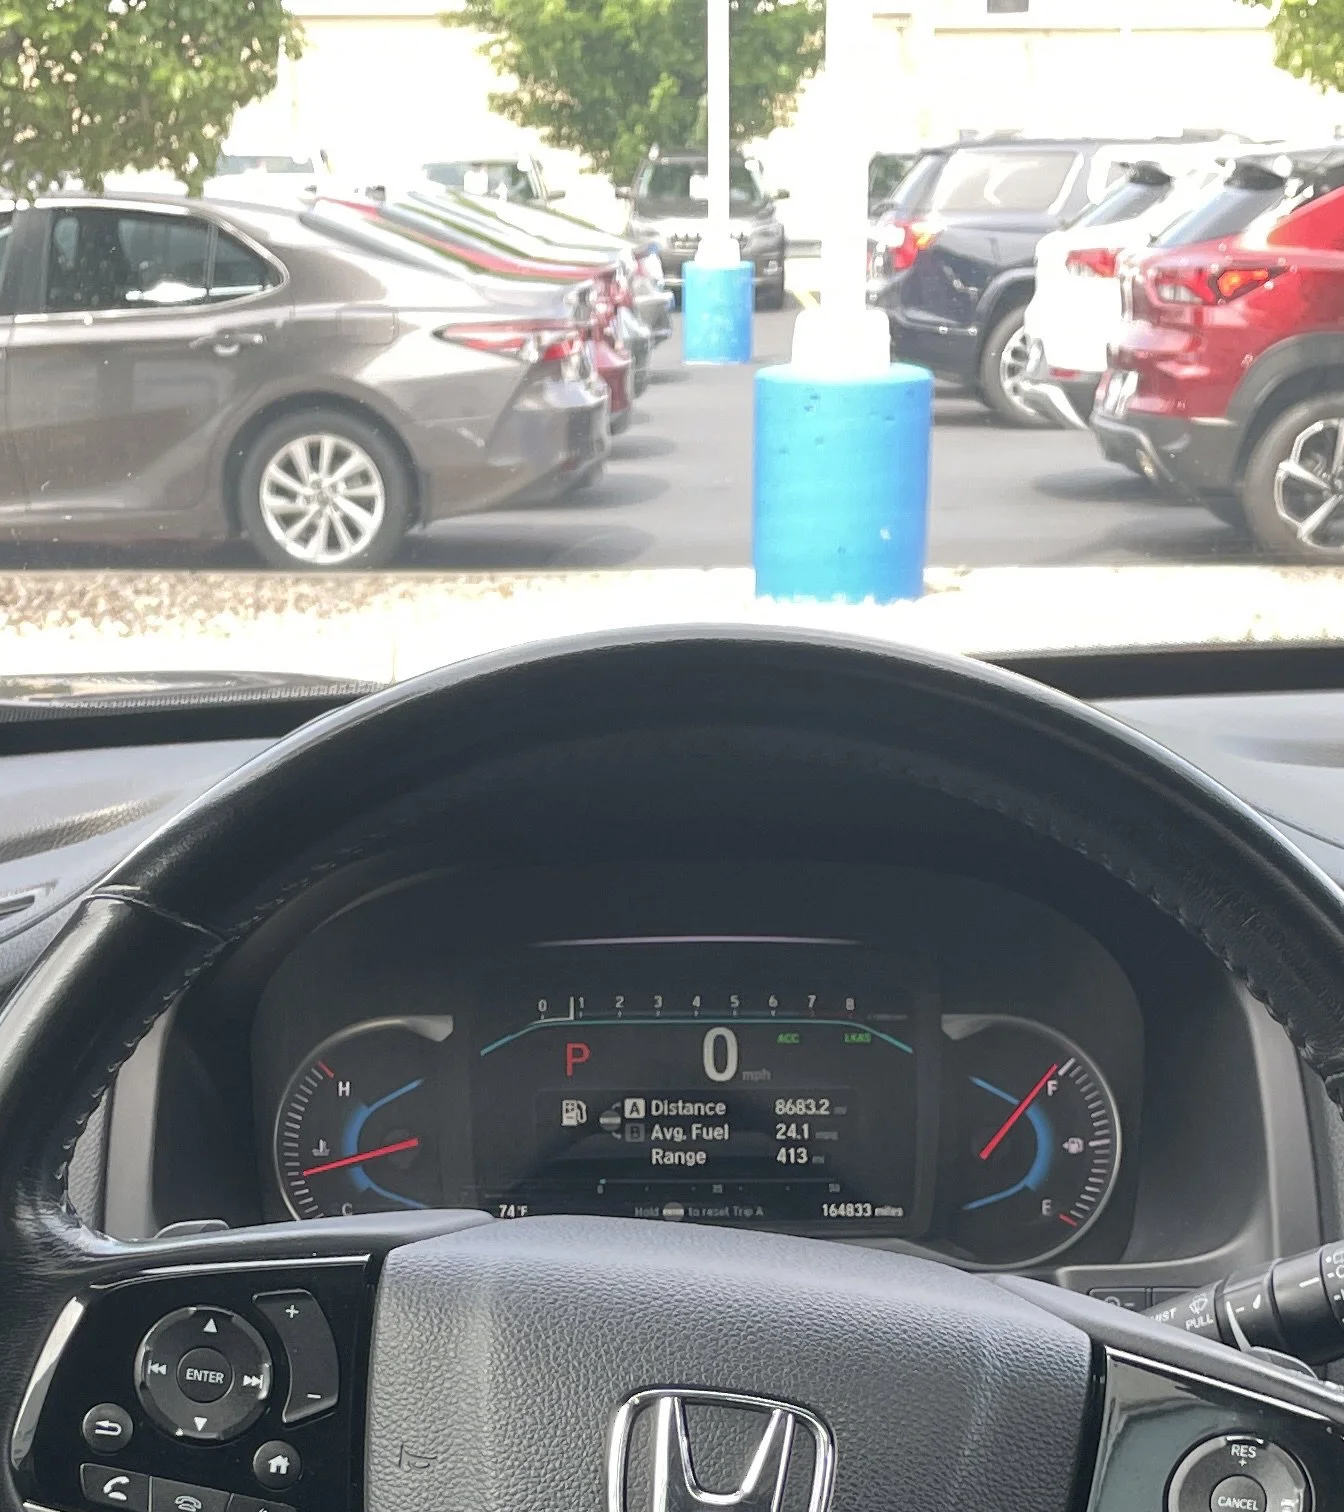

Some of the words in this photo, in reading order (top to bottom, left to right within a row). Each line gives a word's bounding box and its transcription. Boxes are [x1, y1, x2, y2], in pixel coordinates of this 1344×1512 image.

[537, 1000, 547, 1012] 0
[578, 997, 585, 1009] 1
[615, 996, 625, 1008] 2
[654, 995, 663, 1008] 3
[692, 995, 701, 1008] 4
[730, 995, 739, 1008] 5
[768, 995, 778, 1007] 6
[807, 995, 817, 1008] 7
[846, 998, 855, 1011] 8
[776, 1033, 800, 1044] ACC
[566, 1043, 591, 1077] P
[703, 1026, 738, 1082] 0
[742, 1068, 772, 1082] mph
[337, 1080, 351, 1097] H
[1046, 1080, 1058, 1097] F
[651, 1100, 727, 1116] Distance
[775, 1098, 830, 1116] 8683.2
[651, 1123, 687, 1142] Avg.
[691, 1123, 729, 1141] Fuel
[775, 1122, 809, 1140] 24.1
[651, 1148, 707, 1167] Range
[776, 1147, 808, 1164] 413
[341, 1202, 353, 1216] C
[702, 1207, 730, 1218] reset
[754, 1206, 765, 1217] A
[822, 1203, 872, 1217] 164833
[874, 1205, 904, 1218] miles
[1042, 1199, 1053, 1216] E
[1186, 1314, 1214, 1331] PULL
[186, 1367, 225, 1385] ENTER
[1230, 1443, 1257, 1459] RES
[1217, 1495, 1259, 1512] CANCEL
